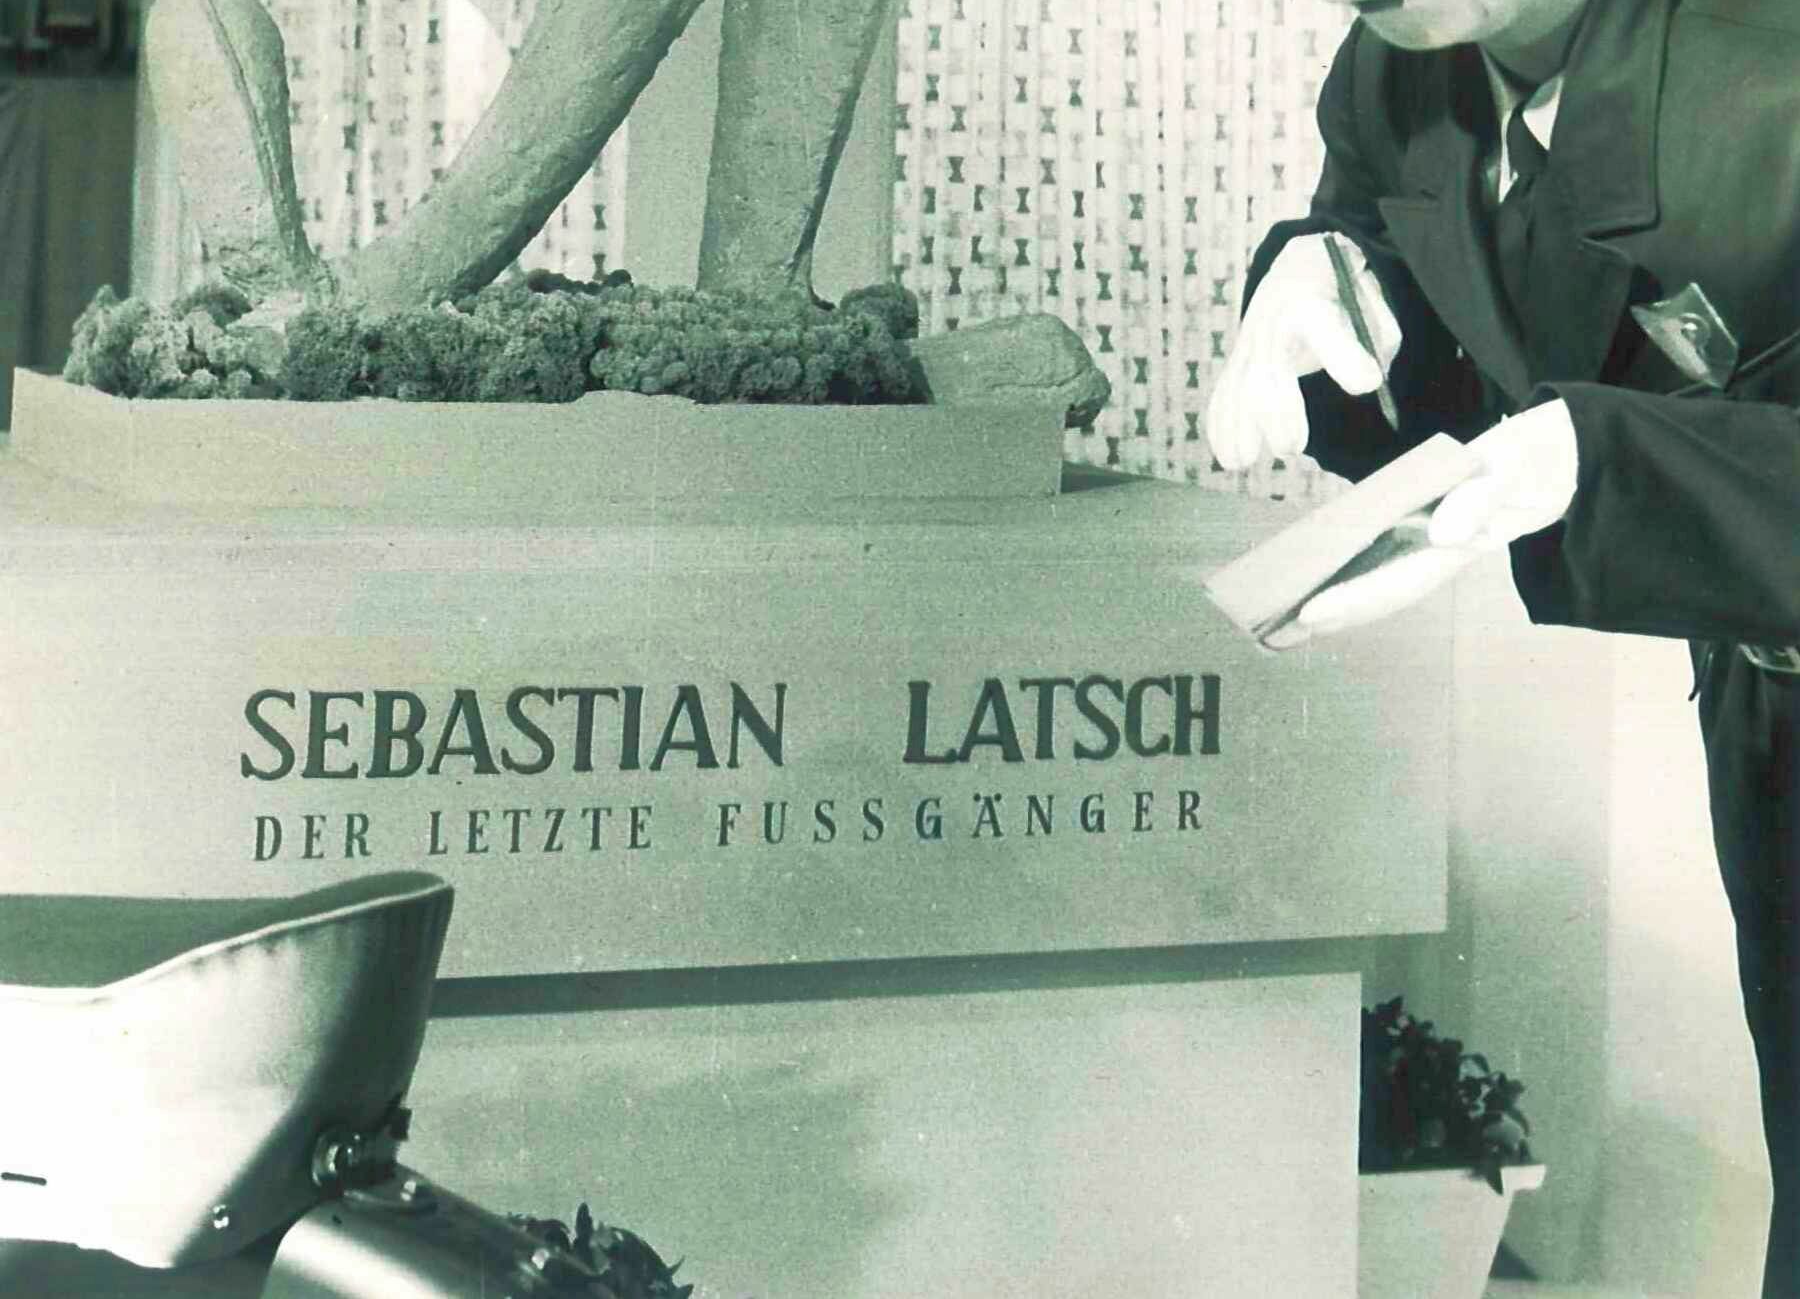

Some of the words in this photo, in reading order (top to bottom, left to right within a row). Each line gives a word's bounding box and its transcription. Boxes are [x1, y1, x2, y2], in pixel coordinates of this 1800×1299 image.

[241, 681, 787, 781] SEBASTIAN
[903, 673, 1221, 765] LATSCH
[254, 813, 371, 861] DER
[429, 806, 651, 856] LETZTE
[718, 790, 1202, 847] FUSSGÄNGER
